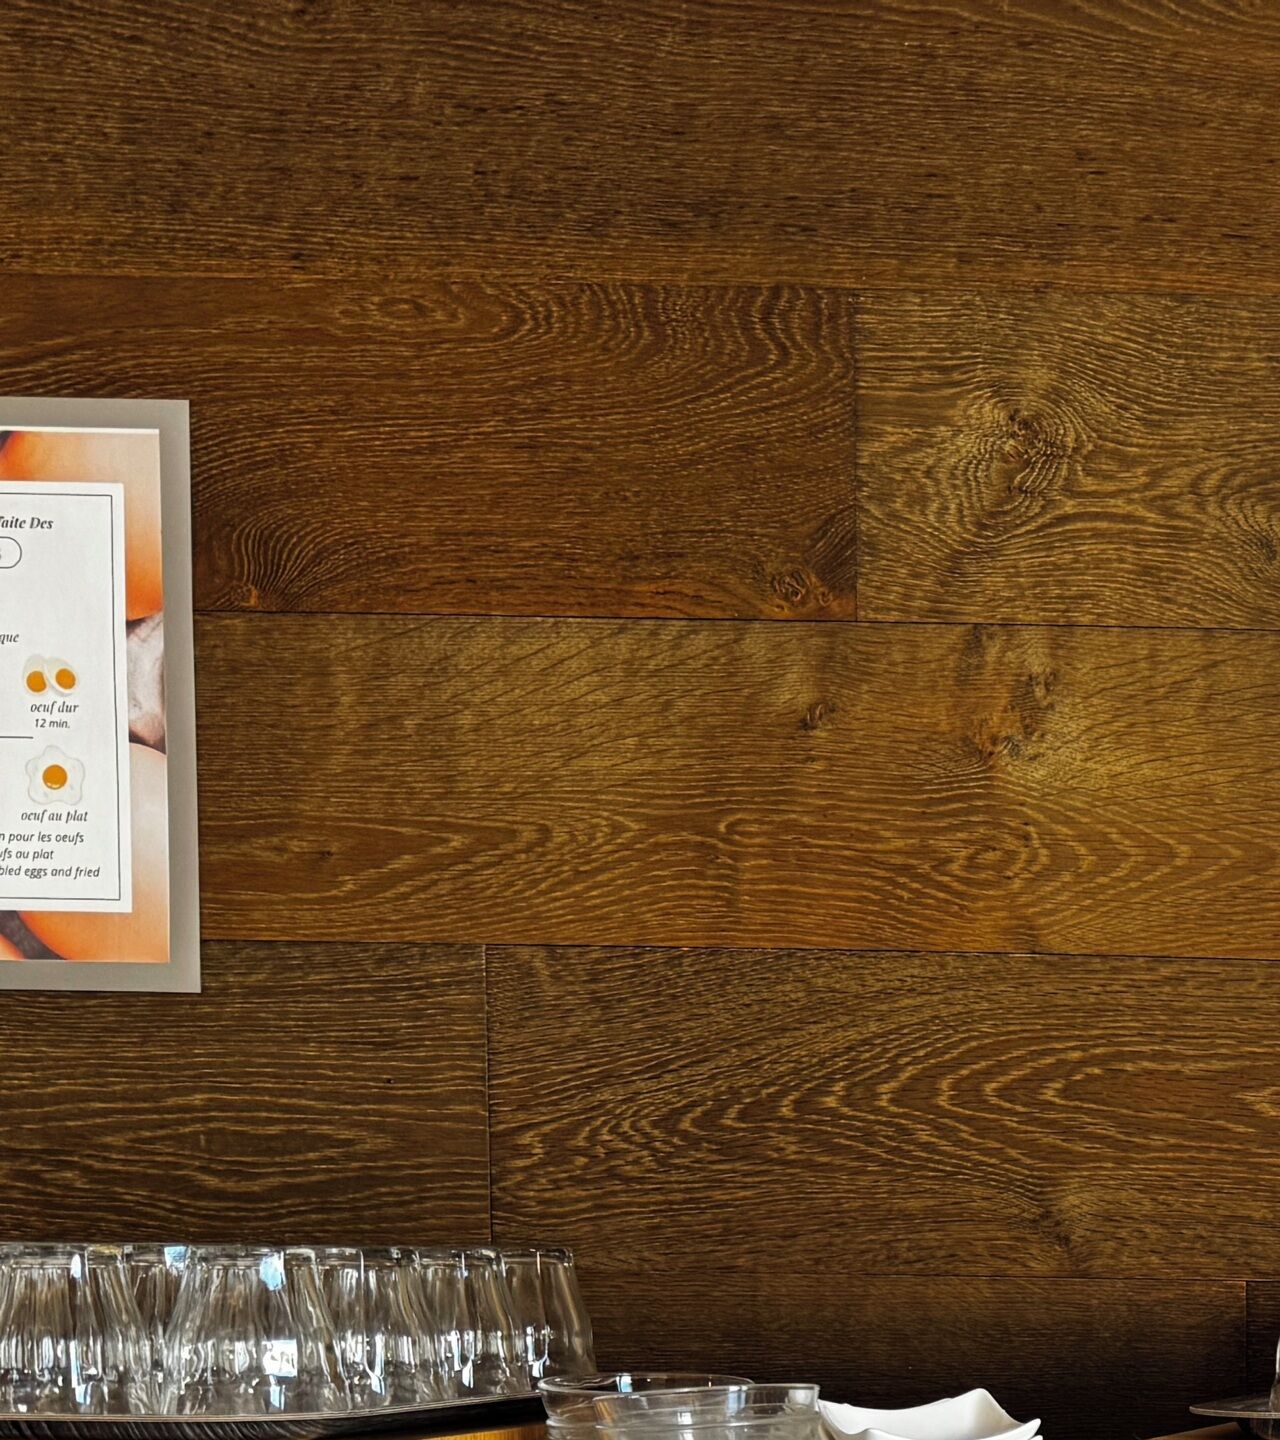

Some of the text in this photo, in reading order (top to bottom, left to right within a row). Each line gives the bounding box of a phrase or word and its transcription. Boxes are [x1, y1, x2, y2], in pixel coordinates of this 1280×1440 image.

[31, 702, 79, 715] oeuf dur
[35, 718, 70, 728] 12 min.
[21, 810, 88, 824] oeuf au plat
[8, 831, 84, 845] pour les oeufs
[15, 849, 54, 861] au plat
[24, 866, 100, 879] eggs and fried
